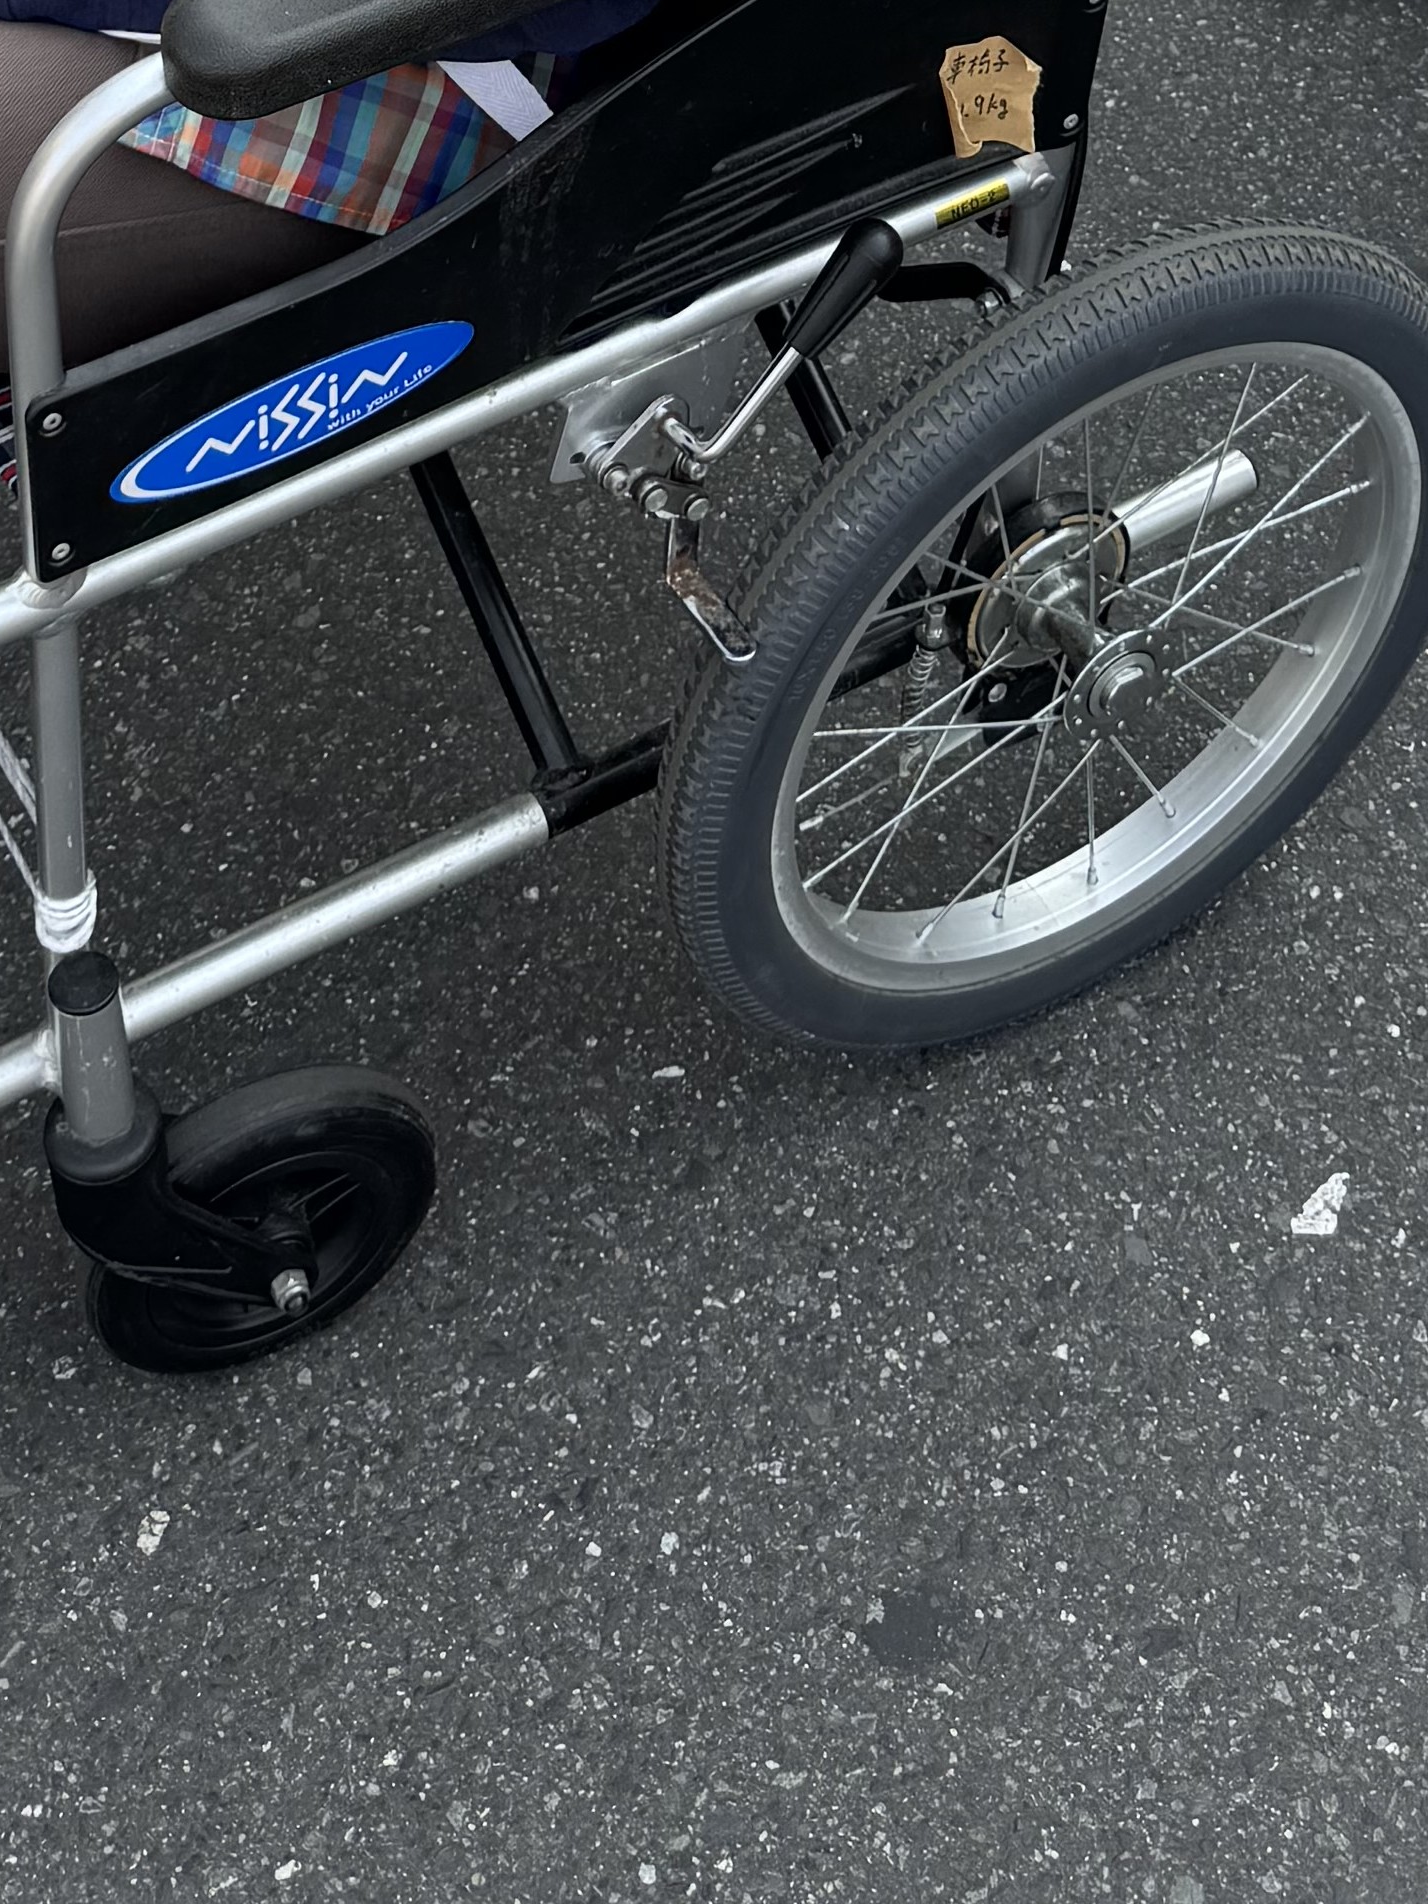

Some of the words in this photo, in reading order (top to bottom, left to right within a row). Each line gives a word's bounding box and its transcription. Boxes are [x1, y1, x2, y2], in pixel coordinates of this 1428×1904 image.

[326, 406, 363, 432] with
[365, 386, 401, 413] your
[403, 363, 435, 390] Life
